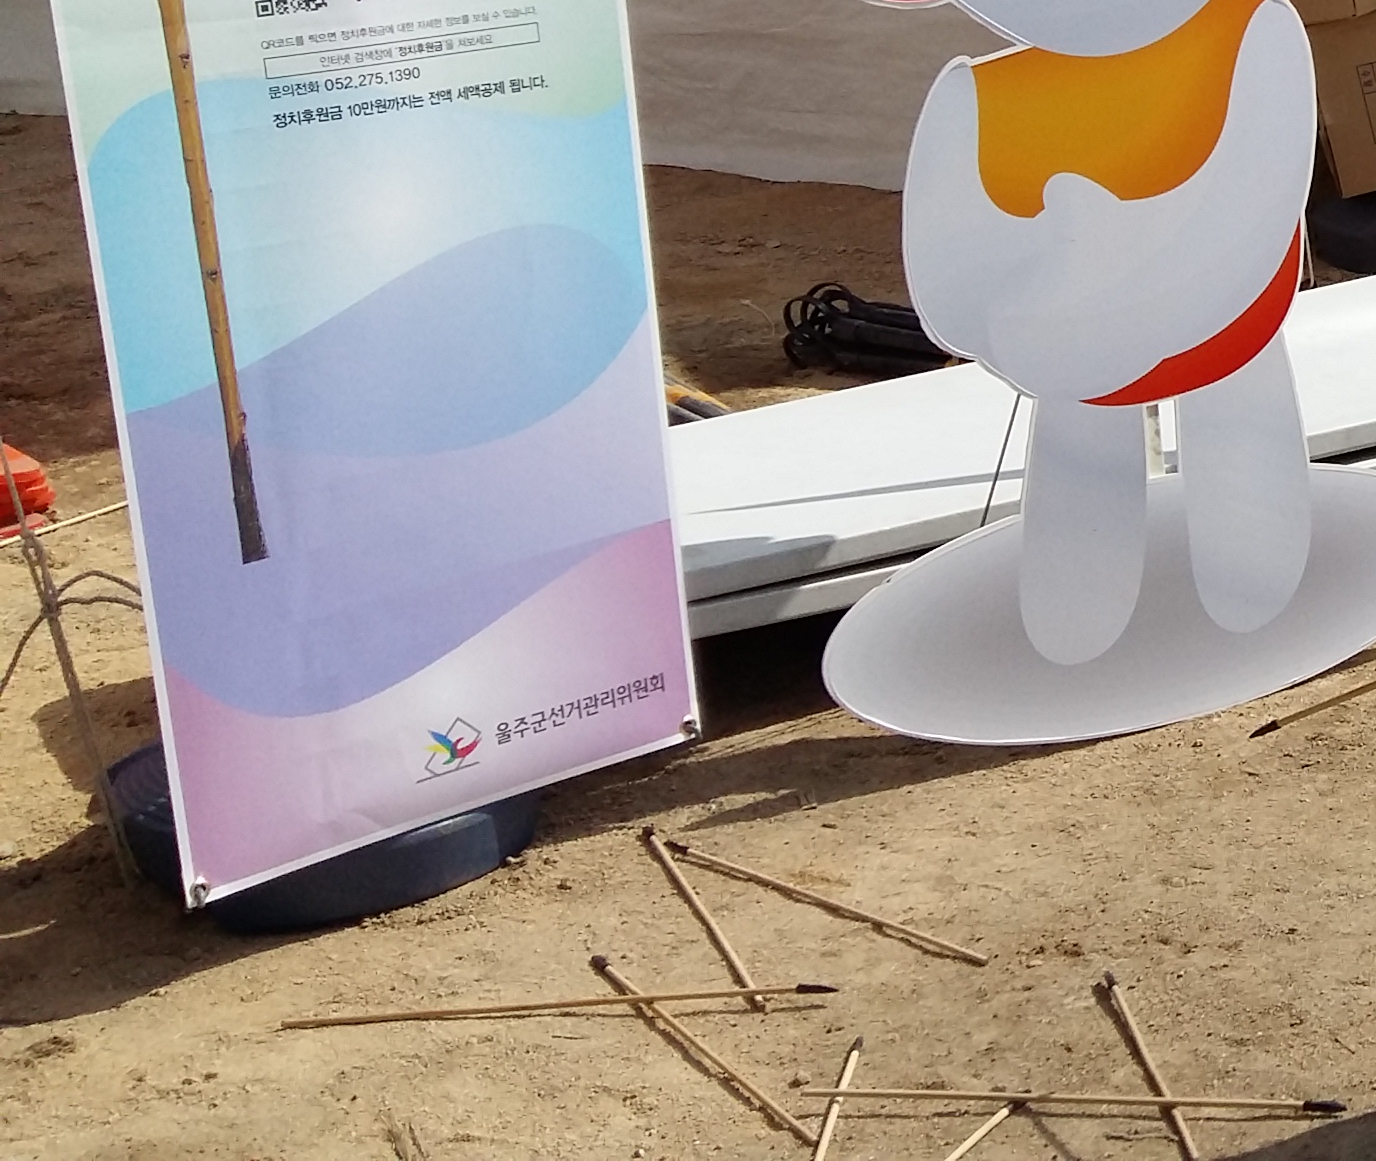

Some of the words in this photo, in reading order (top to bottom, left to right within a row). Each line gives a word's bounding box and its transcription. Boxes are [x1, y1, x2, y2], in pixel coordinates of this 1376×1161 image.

[268, 81, 320, 100] 문의전화
[324, 67, 421, 91] 052.275.1390
[273, 105, 343, 128] 정치후원금
[347, 94, 425, 118] 10만원까지는
[428, 89, 453, 106] 전액
[457, 81, 505, 100] 세액공제
[509, 75, 549, 93] 됩니다.
